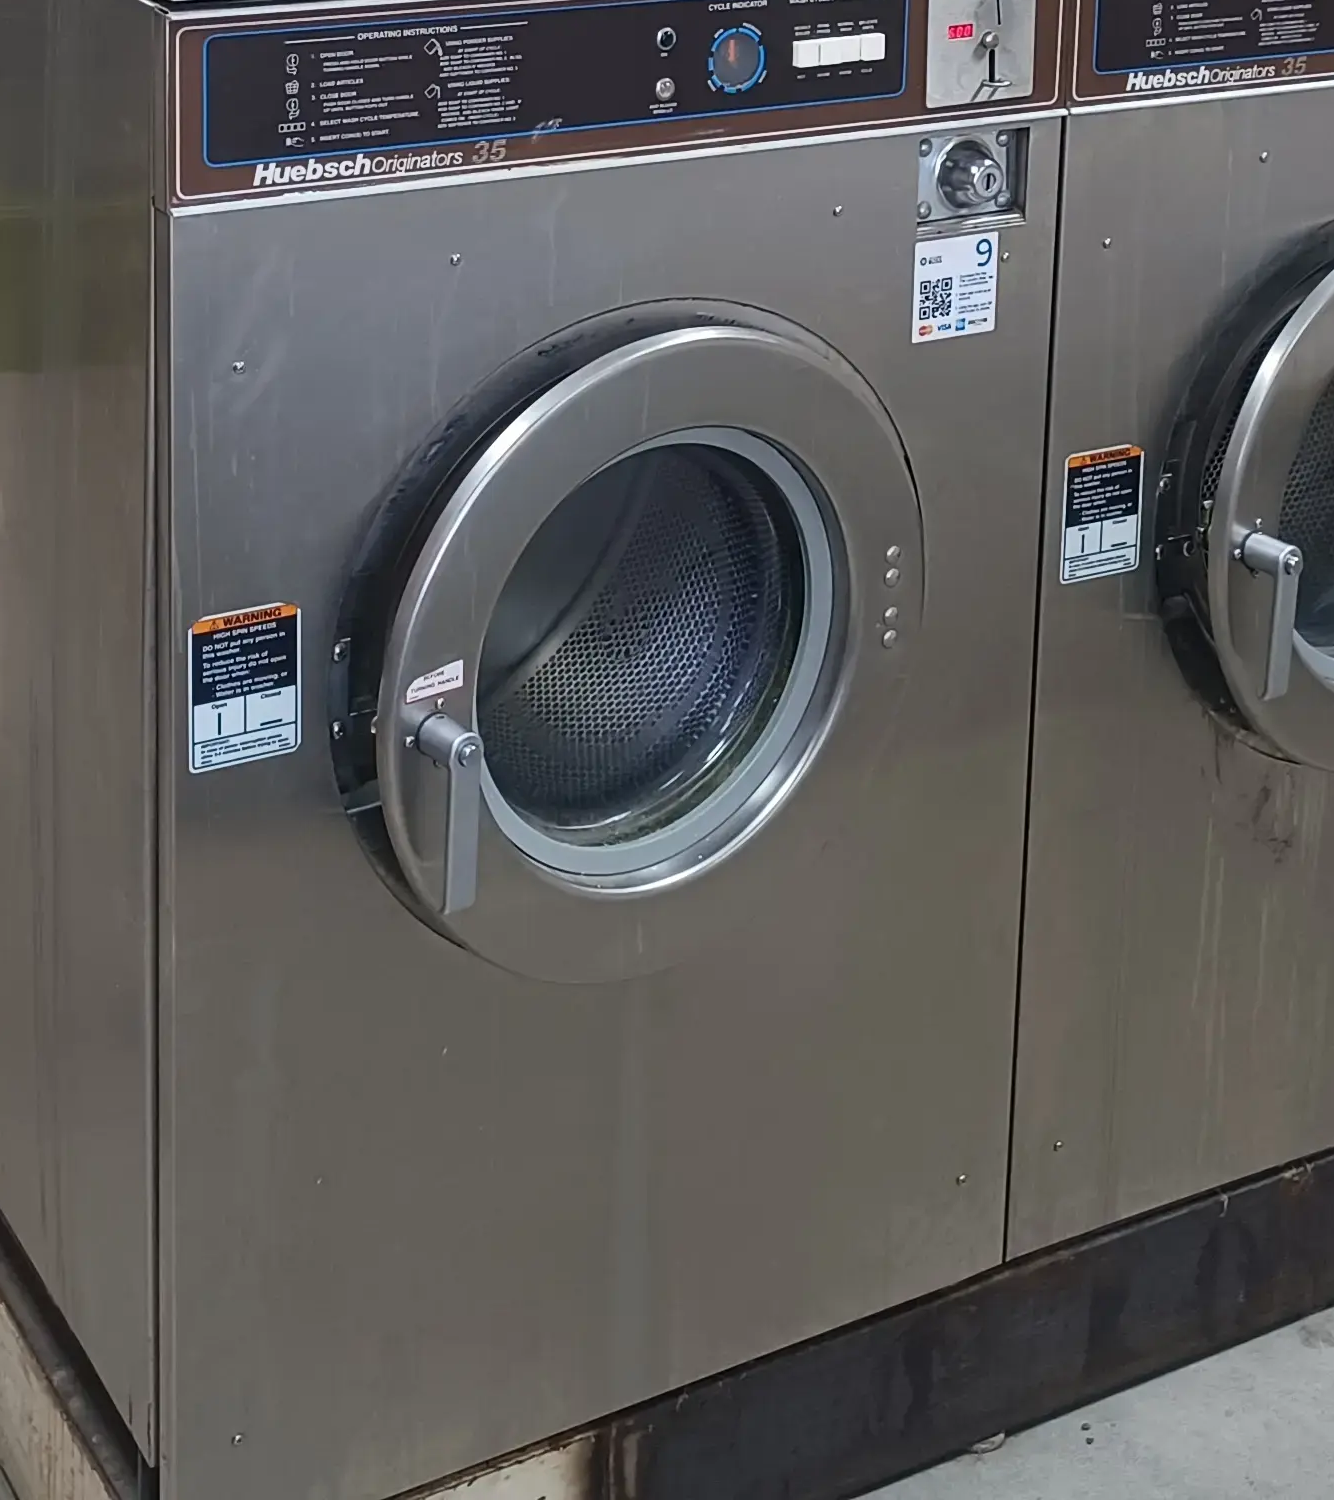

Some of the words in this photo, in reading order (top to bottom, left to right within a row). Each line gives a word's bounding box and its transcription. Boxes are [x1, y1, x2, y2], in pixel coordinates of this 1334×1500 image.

[708, 2, 730, 12] CYCLE
[732, 0, 768, 10] INDICATOR
[357, 29, 401, 40] OPERATING
[403, 24, 458, 37] INSTRUCTIONS
[1125, 65, 1210, 92] Huebsch
[1210, 63, 1275, 83] Originators
[1281, 56, 1307, 75] 35
[253, 154, 371, 187] Huebsch
[372, 150, 464, 174] Originators
[471, 139, 508, 164] 35
[976, 238, 992, 267] 9
[1089, 447, 1131, 463] WARNING
[223, 607, 282, 627] WARNING
[213, 631, 231, 640] HIGH
[250, 622, 276, 632] SPEEDS
[214, 642, 229, 650] NOT
[437, 674, 460, 687] HANDLE
